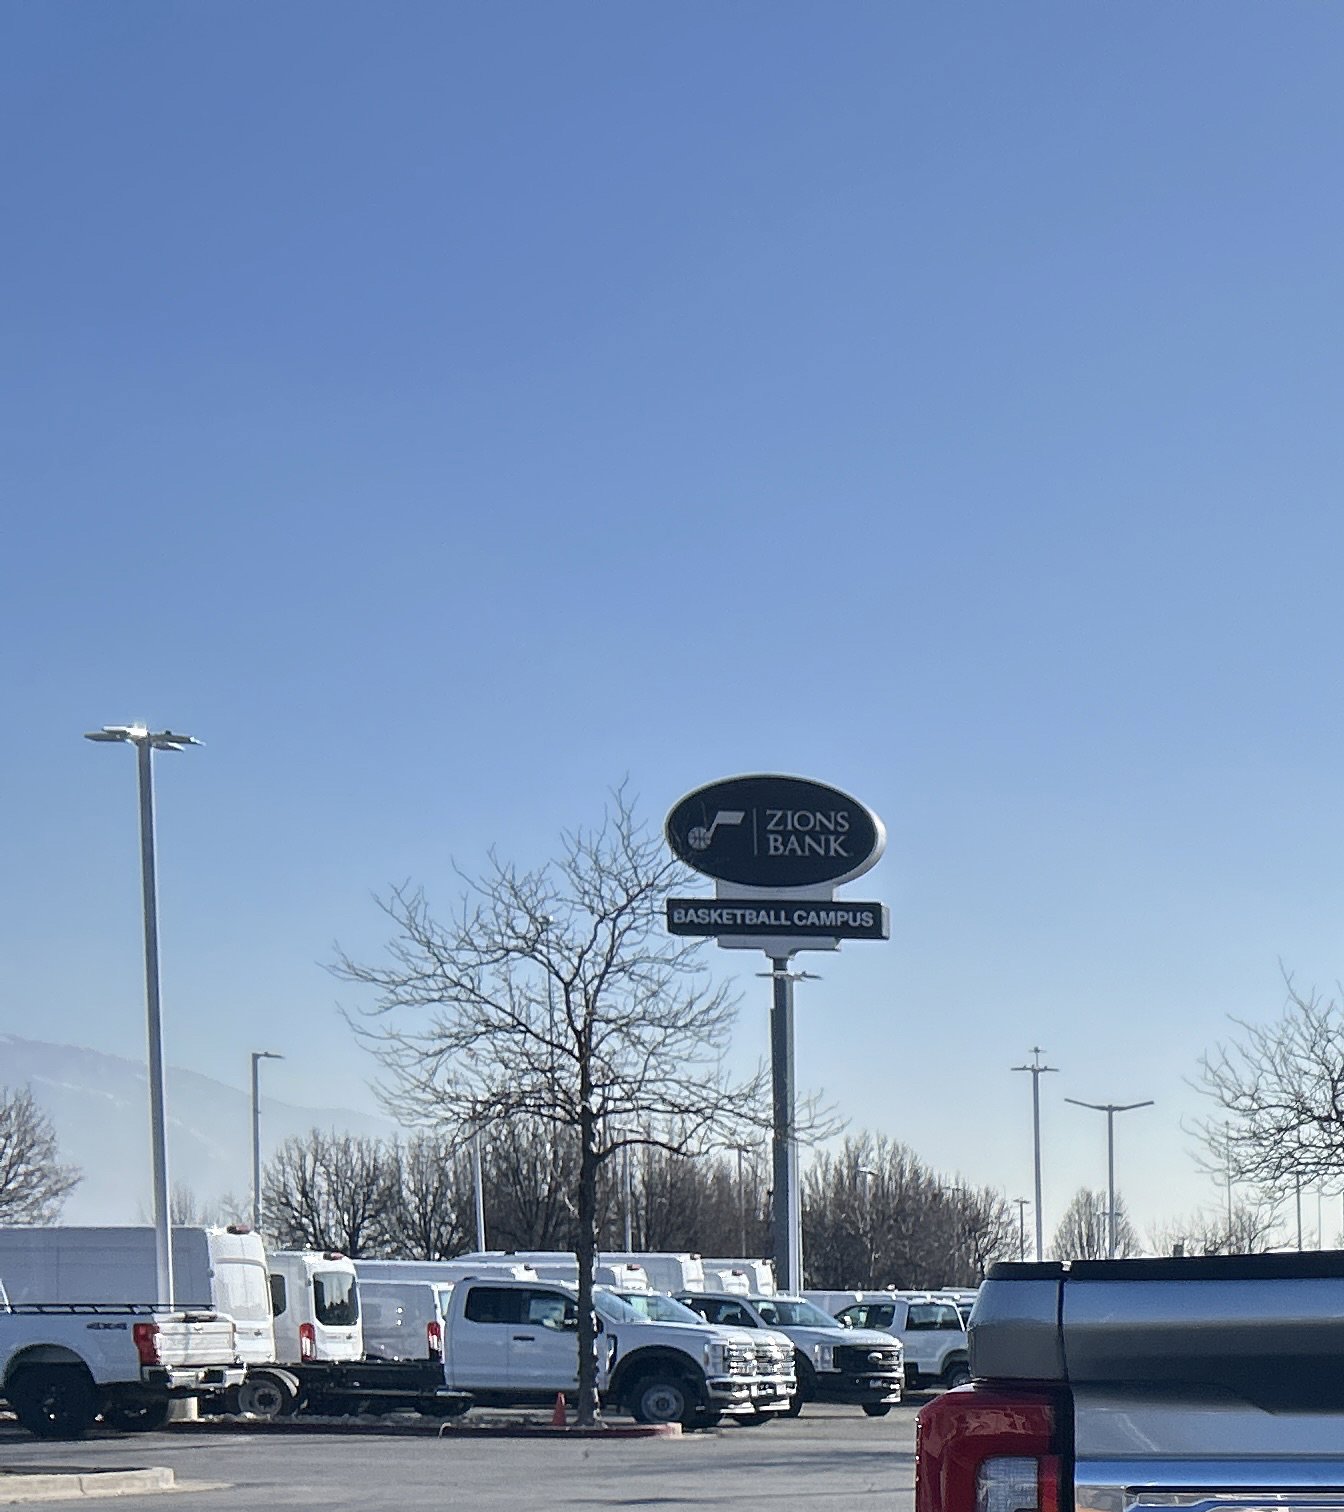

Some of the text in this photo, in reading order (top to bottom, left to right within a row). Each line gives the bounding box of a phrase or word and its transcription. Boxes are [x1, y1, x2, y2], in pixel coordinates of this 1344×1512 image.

[765, 809, 850, 832] ZIONS
[766, 834, 849, 857] BANK
[673, 908, 874, 928] BASKETBALL CAMPUS
